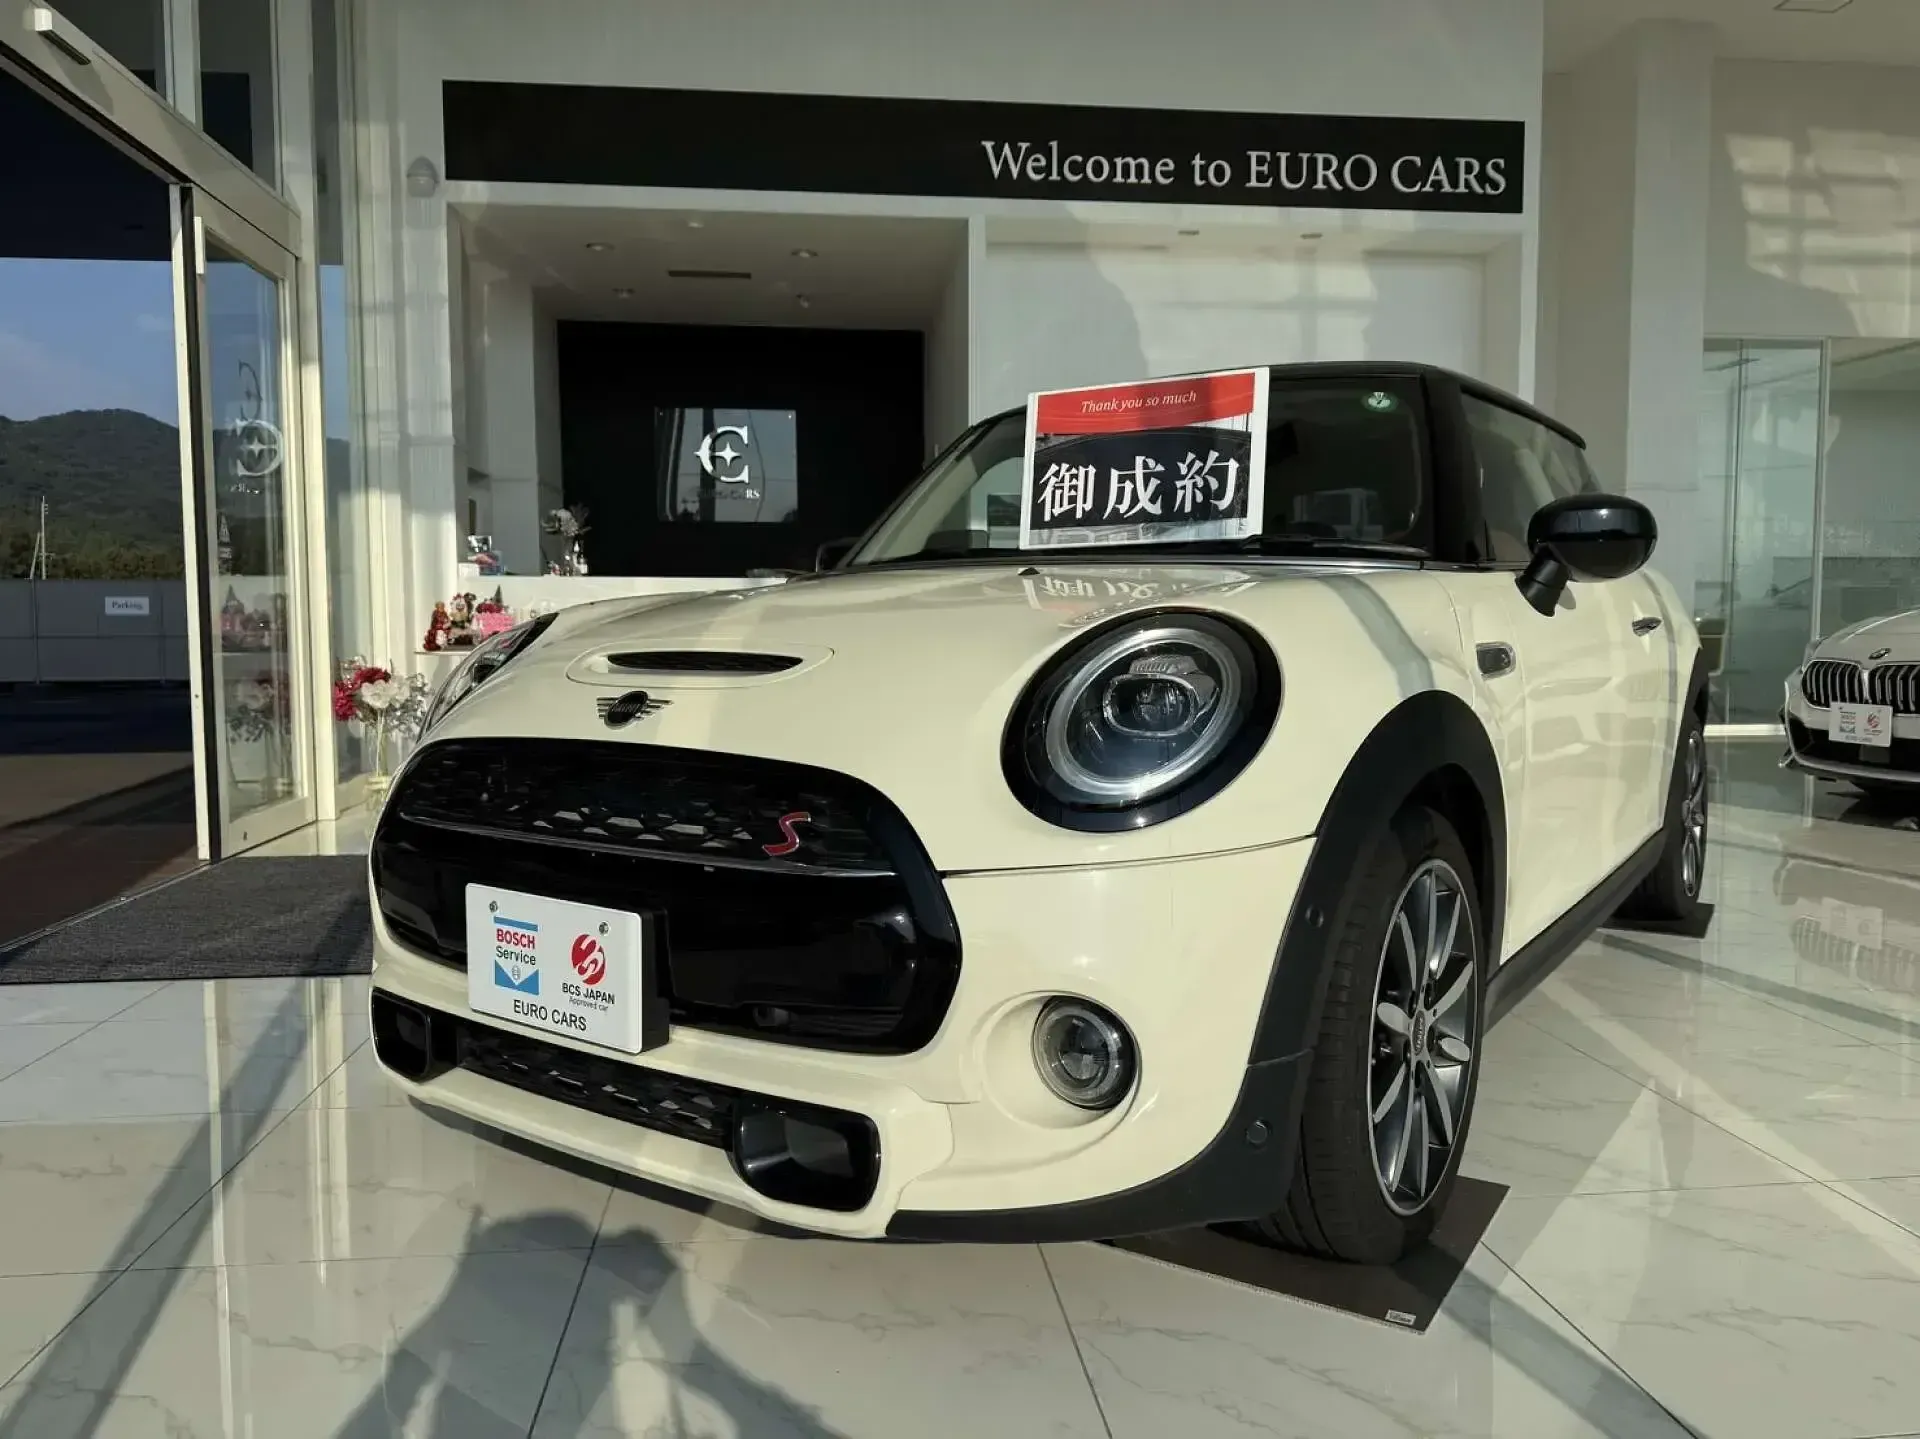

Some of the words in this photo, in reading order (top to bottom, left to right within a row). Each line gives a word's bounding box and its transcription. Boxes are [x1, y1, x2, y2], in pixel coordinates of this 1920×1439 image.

[981, 140, 1175, 185] Welcome
[1191, 152, 1232, 187] to
[1245, 151, 1379, 192] EURO
[1390, 155, 1507, 195] CARS
[1081, 398, 1119, 413] Thank
[1120, 399, 1143, 413] you
[1145, 396, 1159, 407] so
[1162, 390, 1197, 404] much
[1037, 449, 1240, 522] 御成約
[496, 928, 535, 950] BOSCH
[495, 945, 537, 966] Service
[562, 982, 581, 997] BCS
[583, 988, 615, 1005] JAPAN
[513, 999, 548, 1021] EURO
[551, 1009, 587, 1032] CARS
